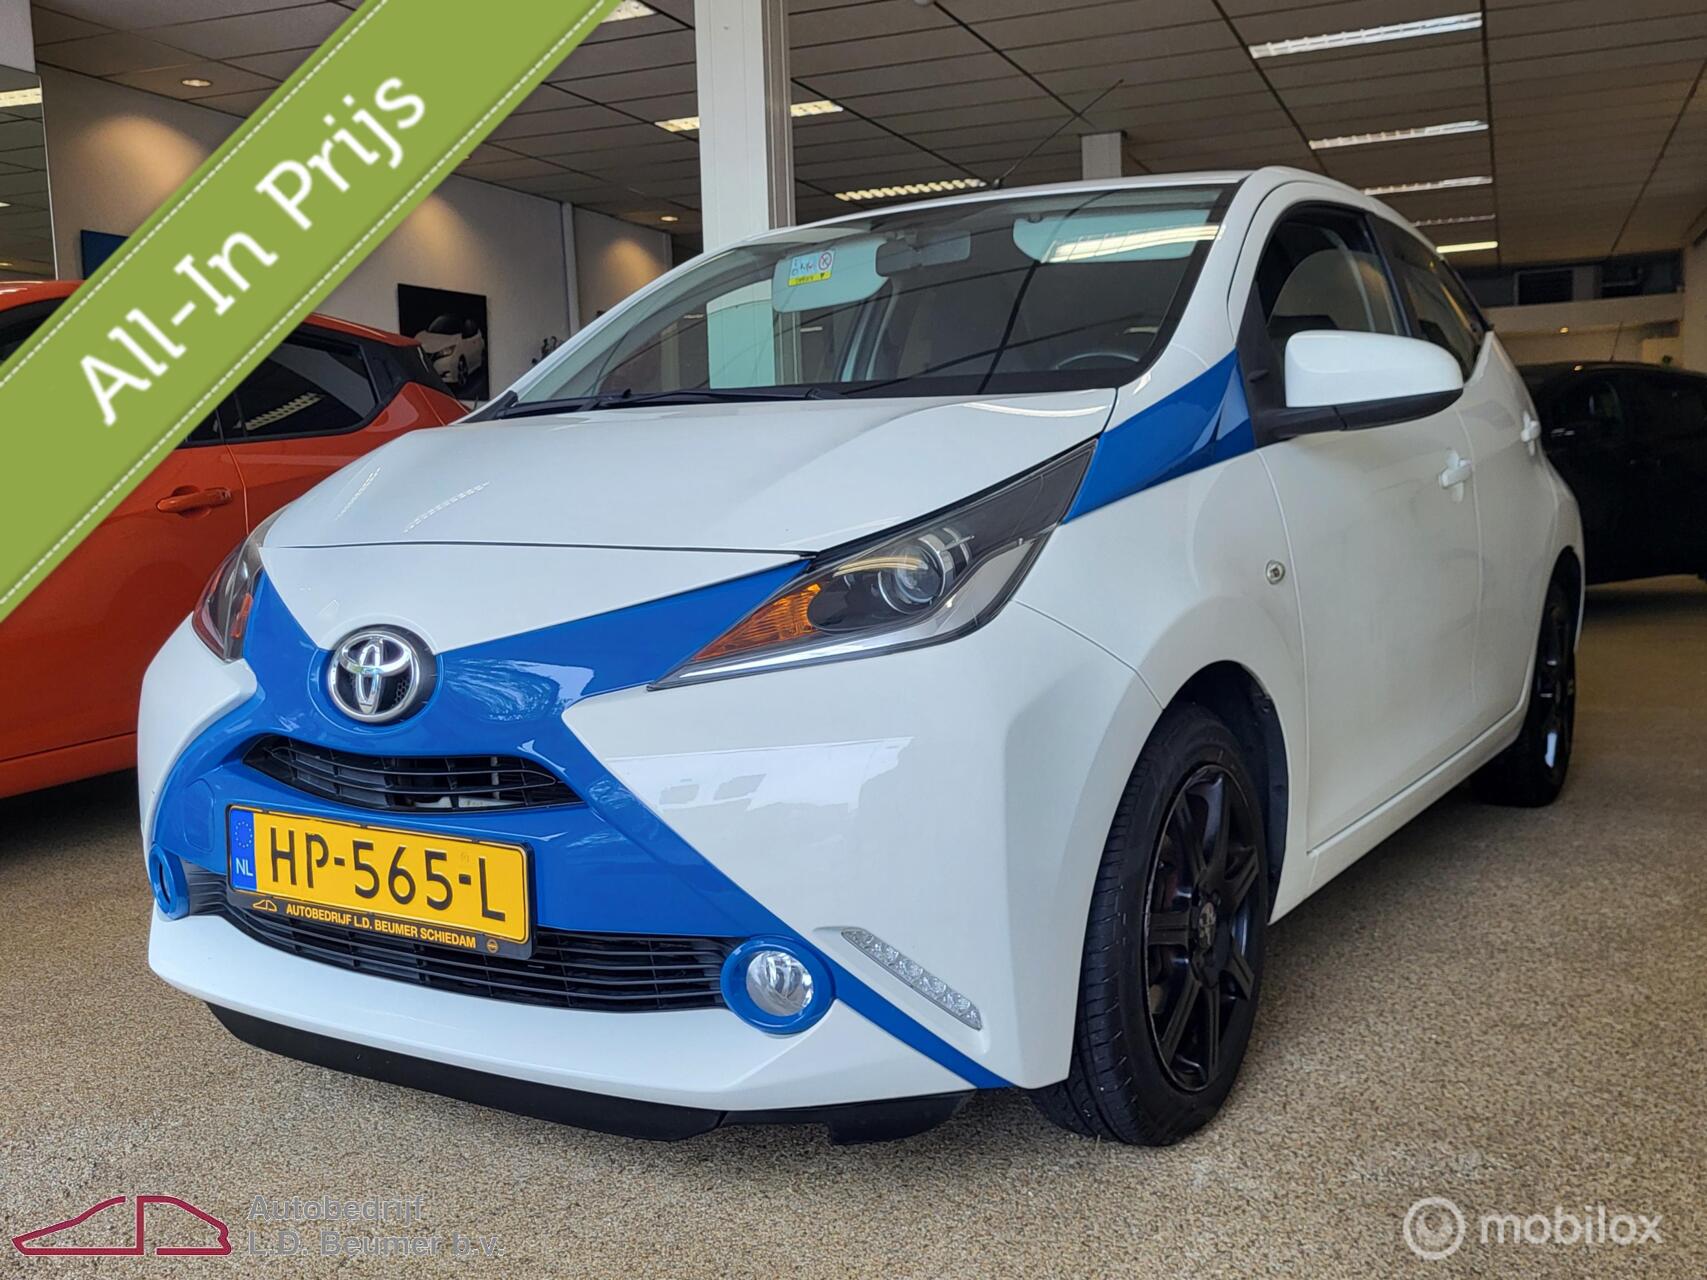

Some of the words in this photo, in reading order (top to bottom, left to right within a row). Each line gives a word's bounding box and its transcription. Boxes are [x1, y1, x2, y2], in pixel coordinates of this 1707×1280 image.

[235, 857, 254, 877] NL
[269, 826, 507, 922] HP-565-L
[286, 903, 353, 926] AUTOBEDRIJF
[353, 915, 373, 930] L.D.
[374, 919, 419, 938] BEUMER
[420, 927, 477, 949] SCHIEDAM
